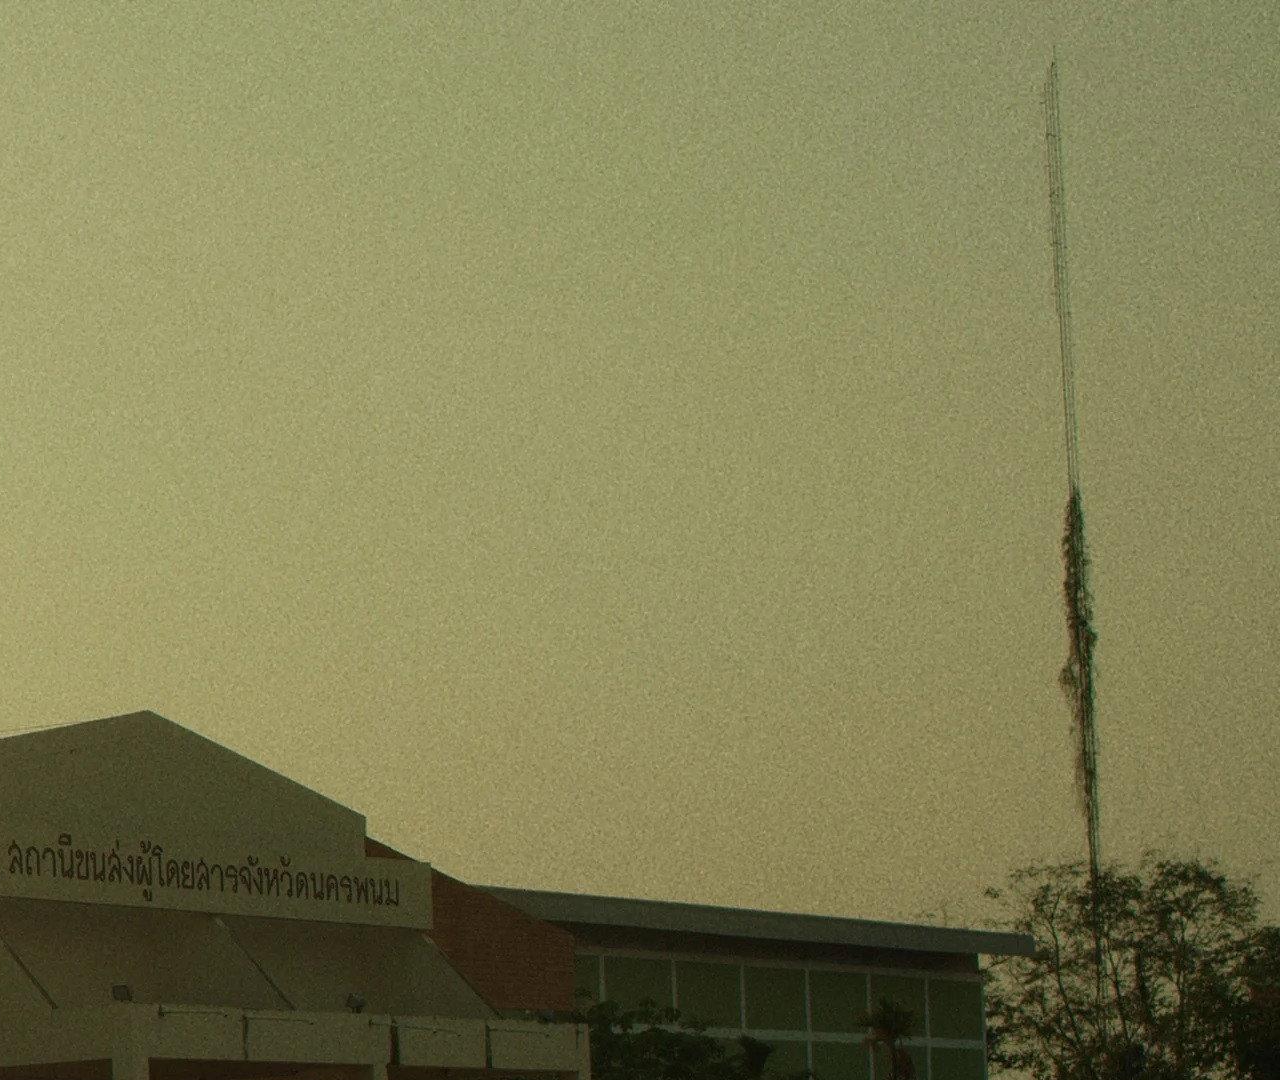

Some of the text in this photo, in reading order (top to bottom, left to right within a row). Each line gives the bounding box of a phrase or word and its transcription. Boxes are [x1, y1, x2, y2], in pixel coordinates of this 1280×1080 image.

[8, 834, 400, 906] สถานีขนส่งผู้โดยสารจังหวัดนครพนม
